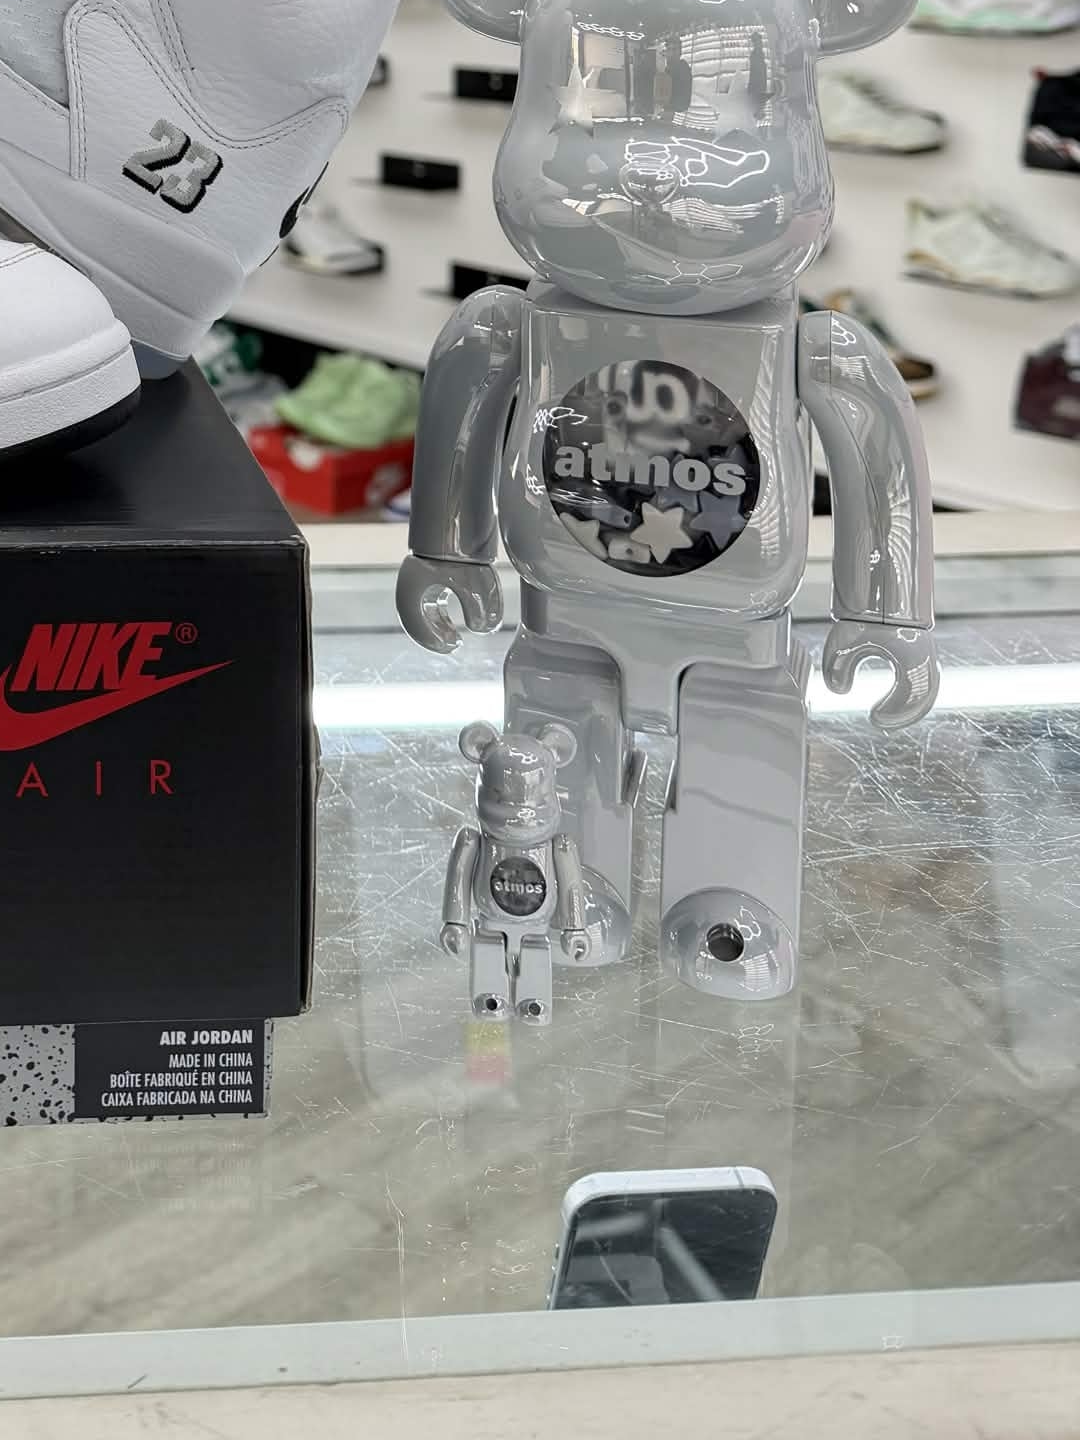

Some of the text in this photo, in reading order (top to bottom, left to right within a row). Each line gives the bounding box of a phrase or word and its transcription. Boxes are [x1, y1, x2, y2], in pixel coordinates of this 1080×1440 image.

[122, 119, 223, 213] 23
[554, 442, 746, 496] atmos
[494, 880, 542, 895] atmos
[160, 1030, 252, 1045] AIR JORDAN
[169, 1052, 253, 1068] MADE IN CHINA
[110, 1069, 253, 1088] BOÎTE FABRIQUÉ EN CHINA
[101, 1089, 253, 1106] CAIXA FABRICADA NA CHINA
